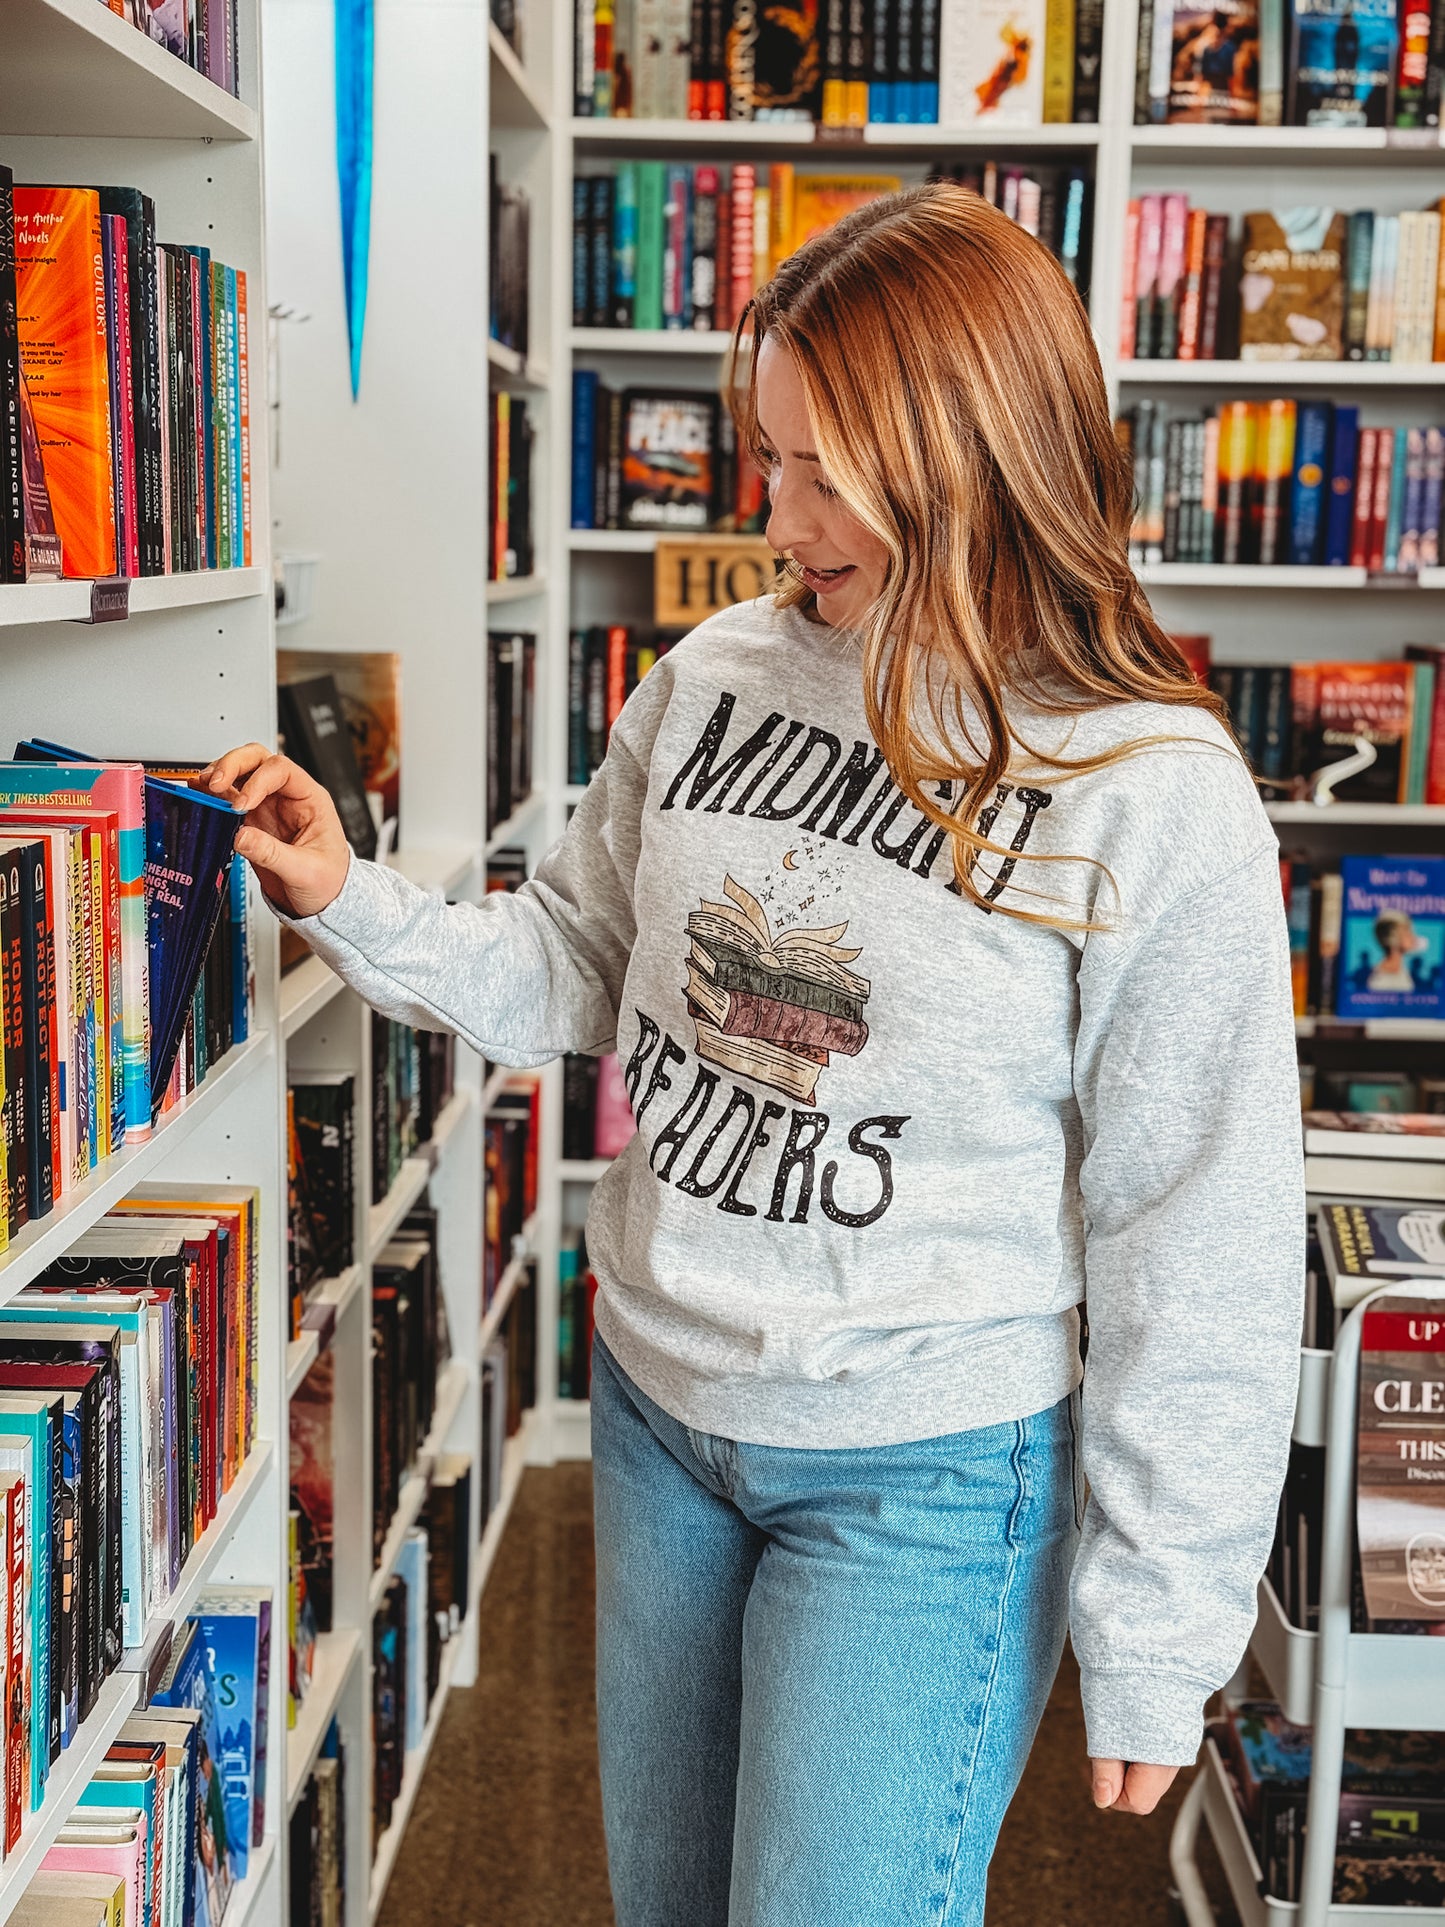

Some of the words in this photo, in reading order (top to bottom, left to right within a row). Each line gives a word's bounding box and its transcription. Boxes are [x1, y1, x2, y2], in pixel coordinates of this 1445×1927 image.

[19, 231, 49, 244] Novels
[34, 256, 57, 264] insight
[94, 254, 105, 336] GUILLORY
[8, 359, 16, 390] J.T.
[126, 356, 134, 424] ENERGY
[149, 363, 157, 432] HEART
[221, 363, 226, 384] WE
[240, 359, 248, 416] LOVERS
[8, 400, 20, 519] GEISSINGER
[13, 793, 38, 804] TIMES
[40, 794, 92, 806] BESTSELLING
[73, 862, 81, 925] HELENA
[82, 859, 90, 922] HELENA
[156, 889, 185, 910] REAL,
[75, 931, 84, 1004] HUNTING
[84, 927, 92, 1002] HUNTING
[94, 886, 102, 998] COMPLICATED
[110, 927, 120, 1019] JIMENEZ
[12, 937, 24, 1049] HONOR
[36, 920, 48, 1062] PROTECT
[142, 965, 150, 1008] ABBY
[77, 1092, 87, 1121] Up
[624, 1006, 912, 1228] READERS
[1408, 1320, 1440, 1341] UP
[1396, 1440, 1445, 1461] THIS
[13, 1488, 23, 1572] DEJA
[12, 1573, 22, 1659] BREW
[156, 1769, 165, 1861] ARCHER'S
